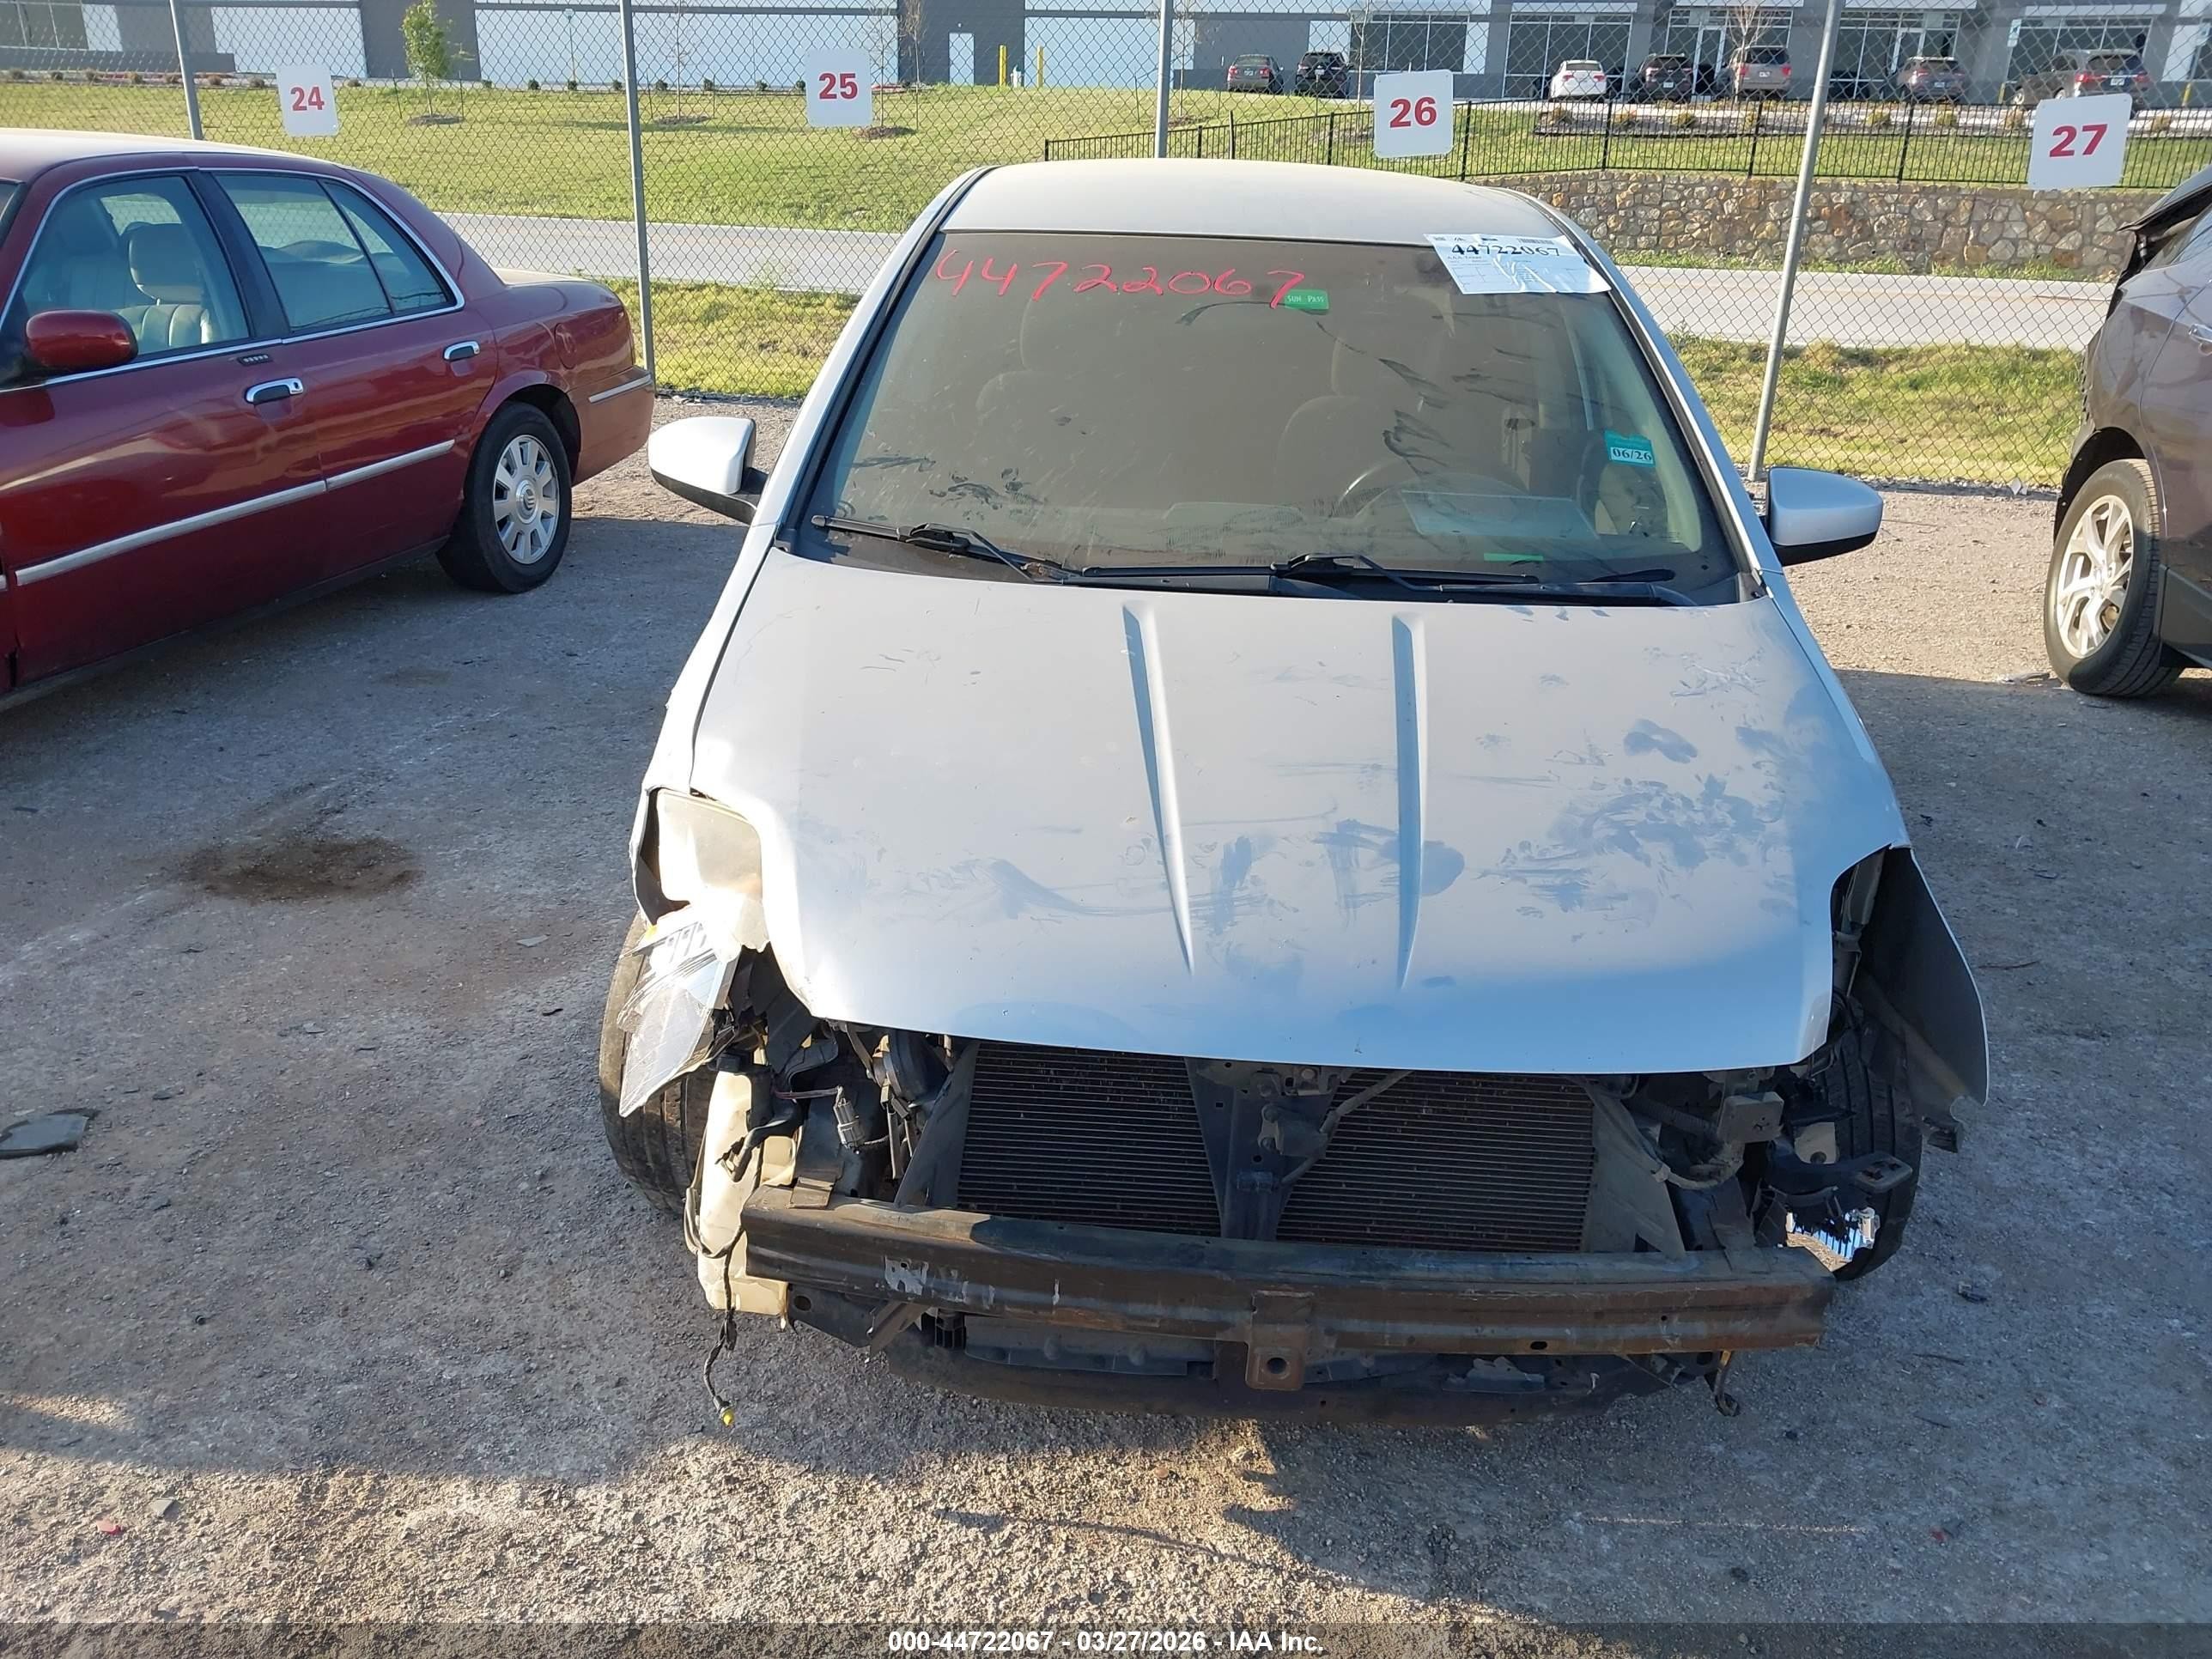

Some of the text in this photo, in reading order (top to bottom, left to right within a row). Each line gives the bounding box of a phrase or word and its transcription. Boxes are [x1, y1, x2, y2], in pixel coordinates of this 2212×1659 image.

[289, 86, 325, 112] 24
[817, 72, 859, 100] 25
[1389, 95, 1438, 130] 26
[2048, 123, 2109, 159] 27
[1451, 243, 1560, 257] 44722067
[936, 249, 1305, 310] 44722067
[1286, 295, 1302, 303] SUN
[1613, 447, 1653, 462] 06/26
